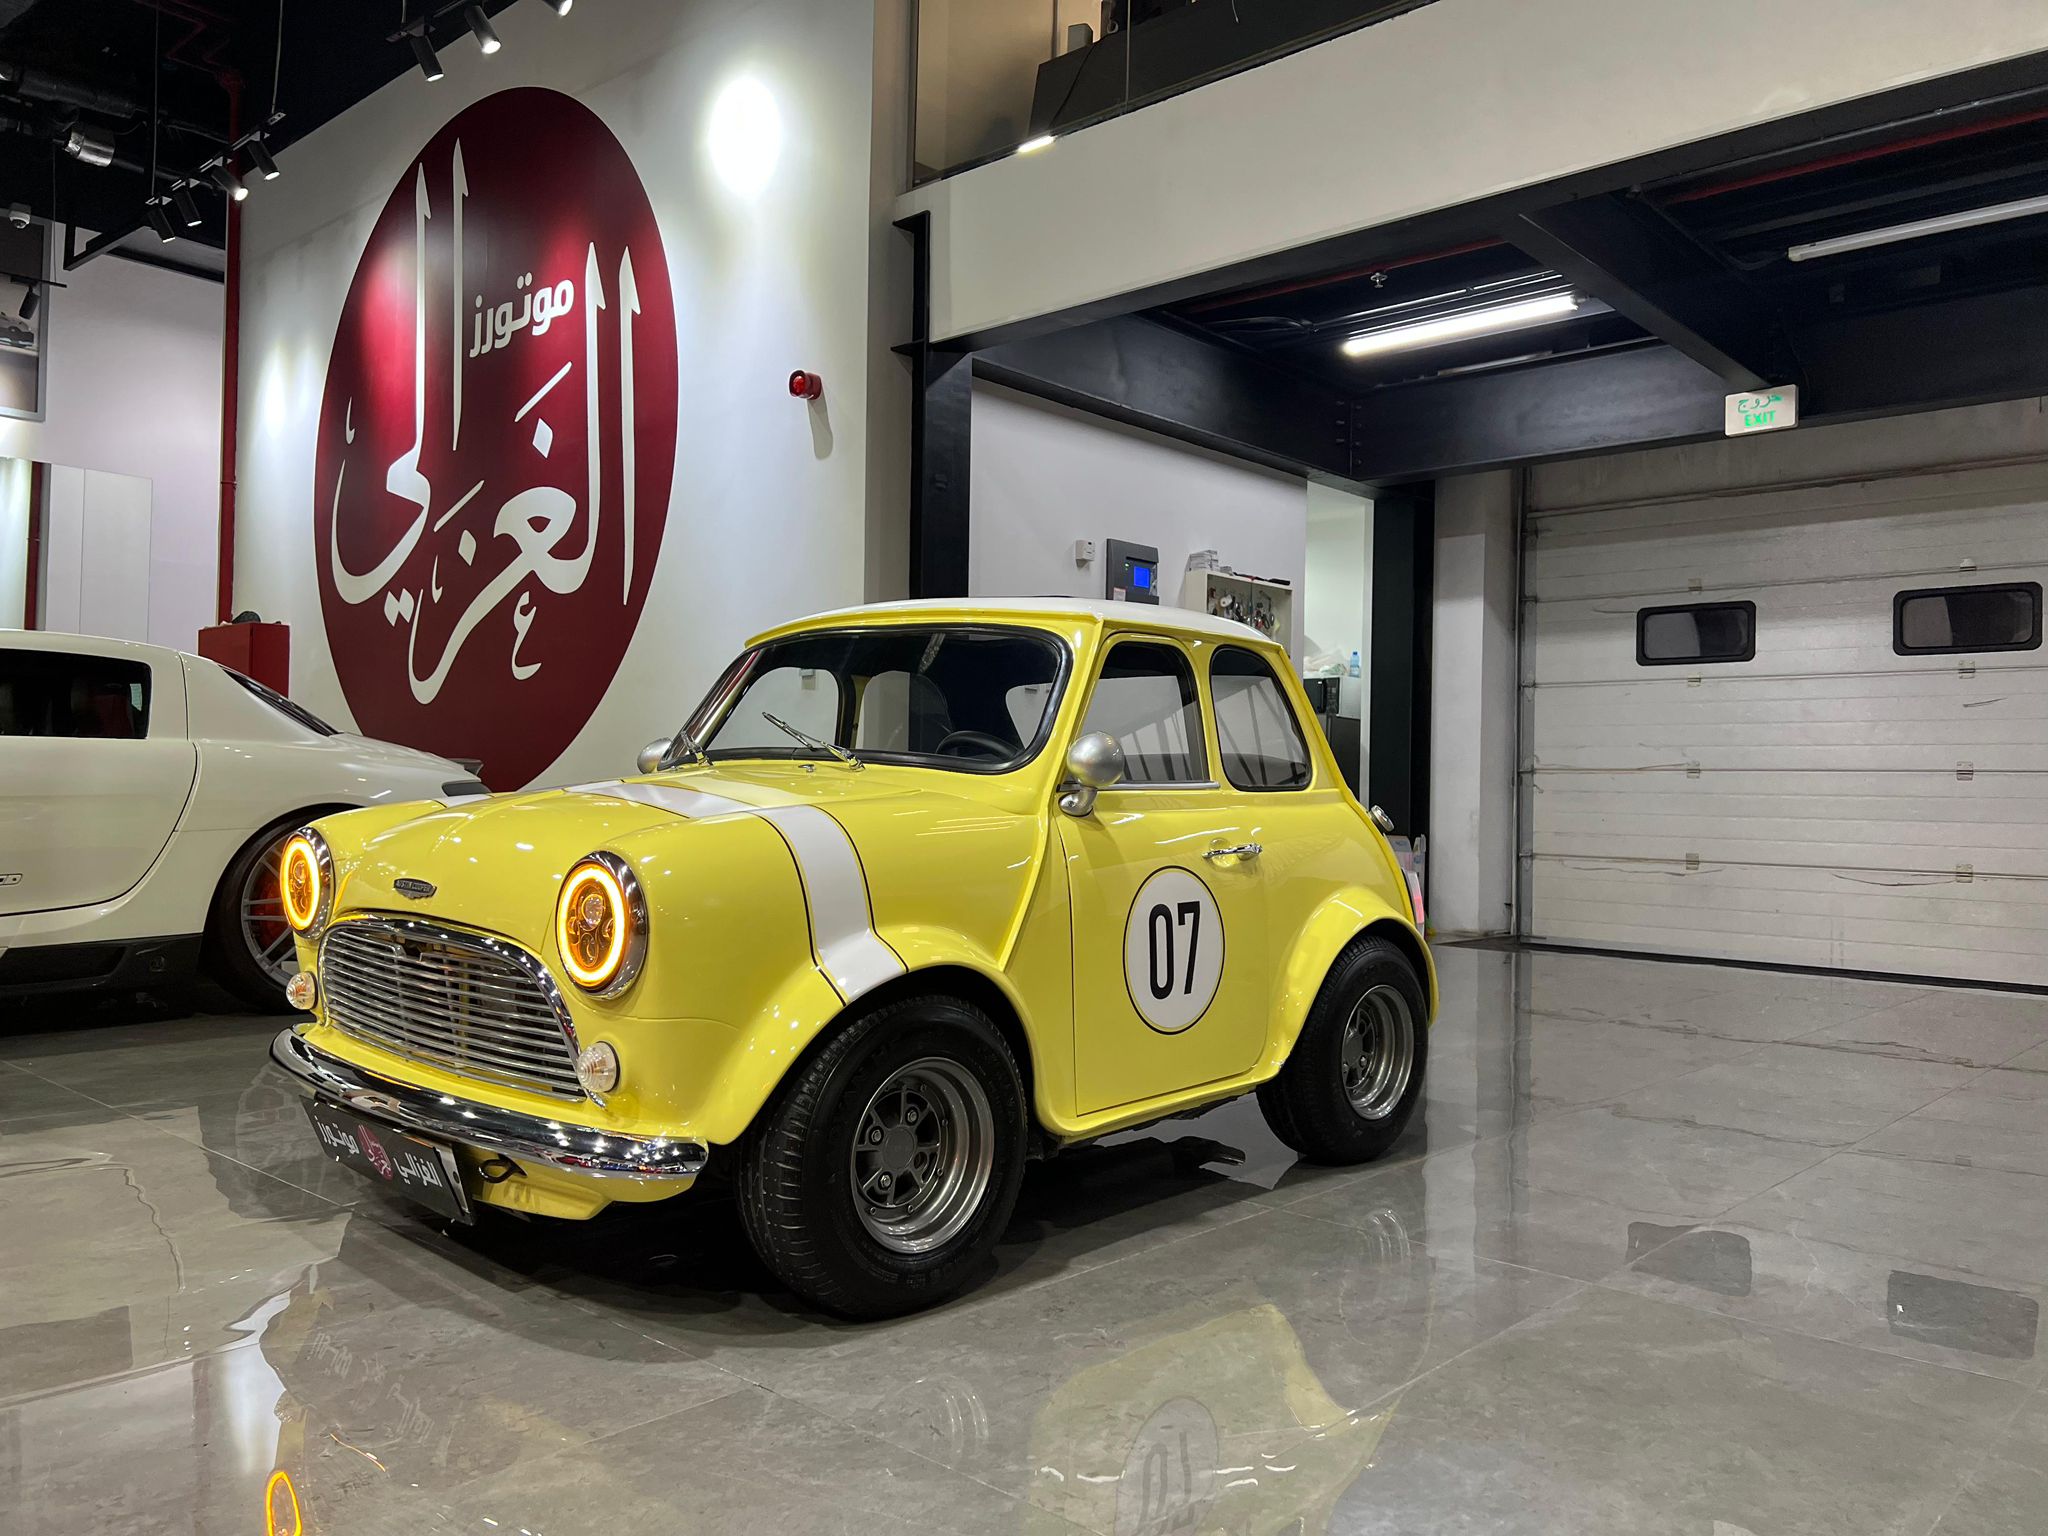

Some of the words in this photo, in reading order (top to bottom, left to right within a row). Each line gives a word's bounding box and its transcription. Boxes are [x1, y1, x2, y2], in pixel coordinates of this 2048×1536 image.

[469, 272, 574, 357] موتورز
[1744, 410, 1776, 427] EXIT
[1149, 901, 1200, 999] 07
[314, 1115, 360, 1155] موتورز
[393, 1152, 443, 1187] الغزالي
